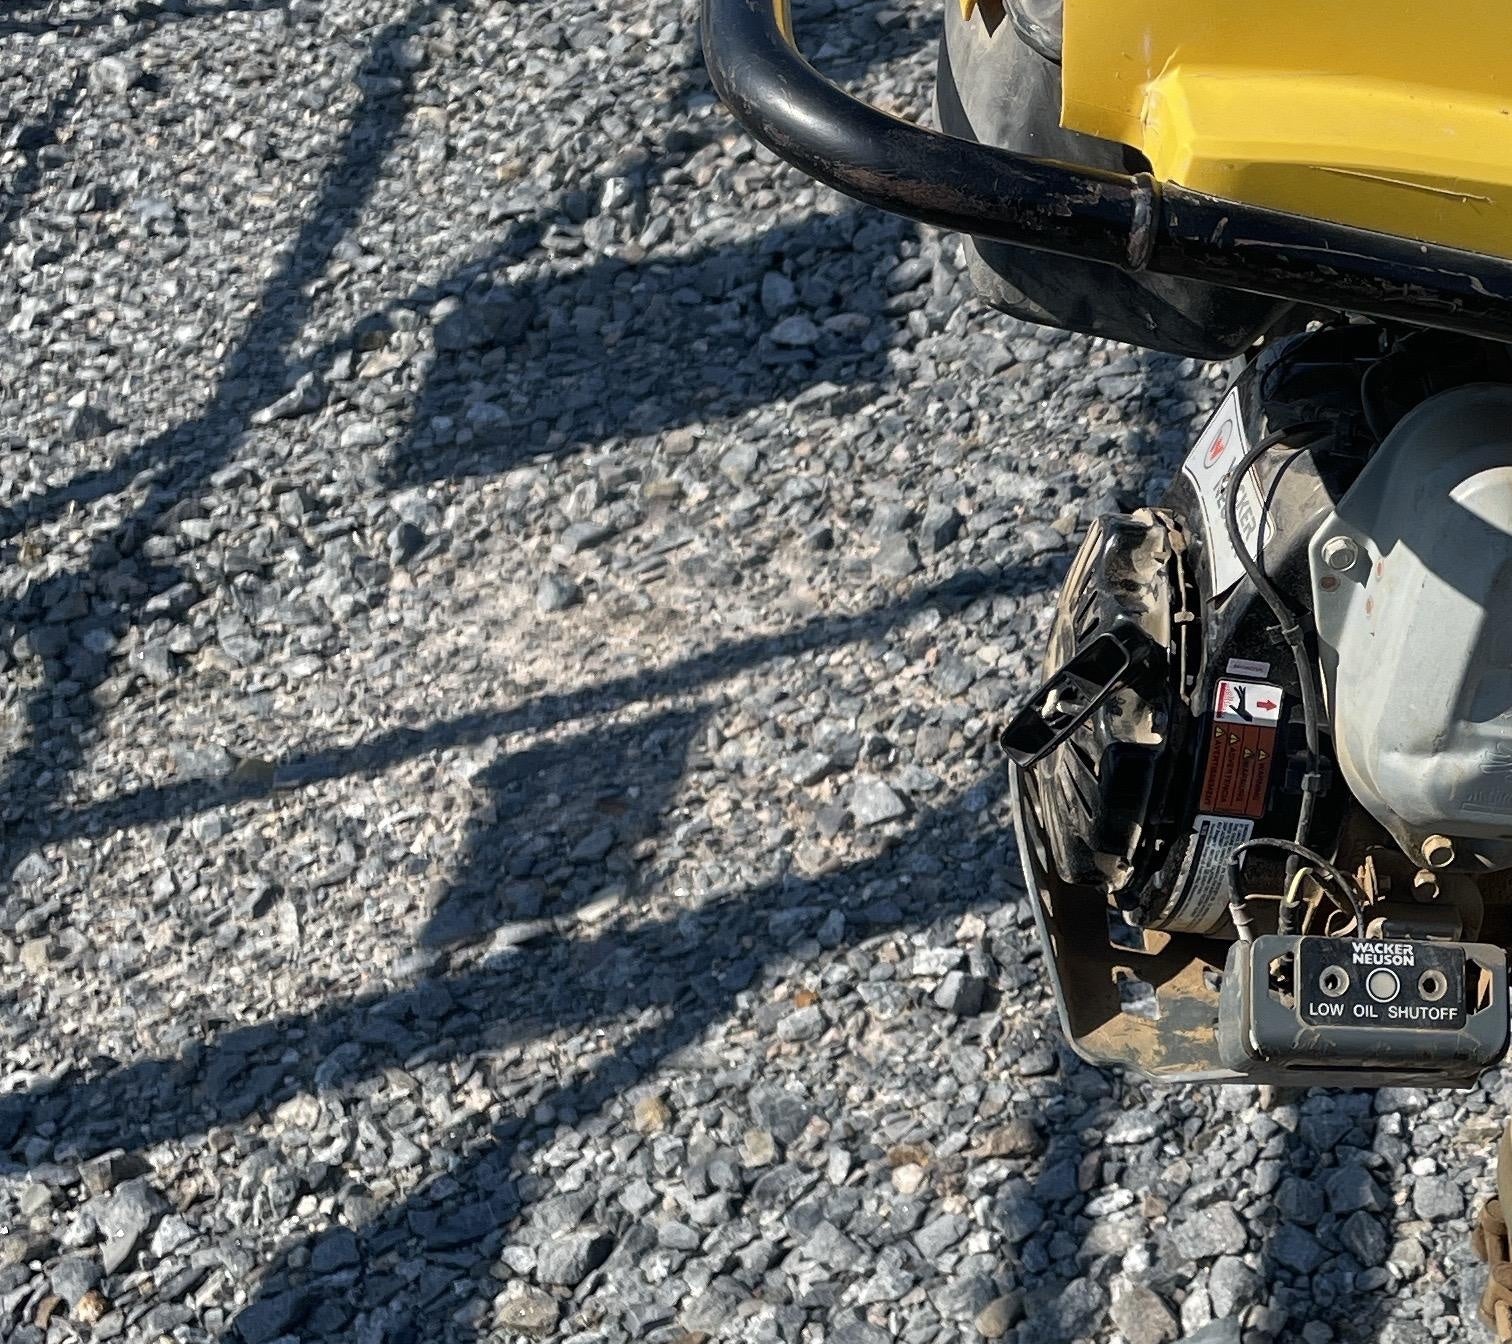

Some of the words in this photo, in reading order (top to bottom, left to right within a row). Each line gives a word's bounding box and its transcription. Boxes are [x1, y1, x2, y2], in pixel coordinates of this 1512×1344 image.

[1352, 942, 1414, 956] WACKER
[1352, 953, 1415, 967] NEUSON
[1309, 1002, 1345, 1017] LOW
[1353, 1004, 1379, 1018] OIL
[1388, 1005, 1459, 1021] SHUTOFF
